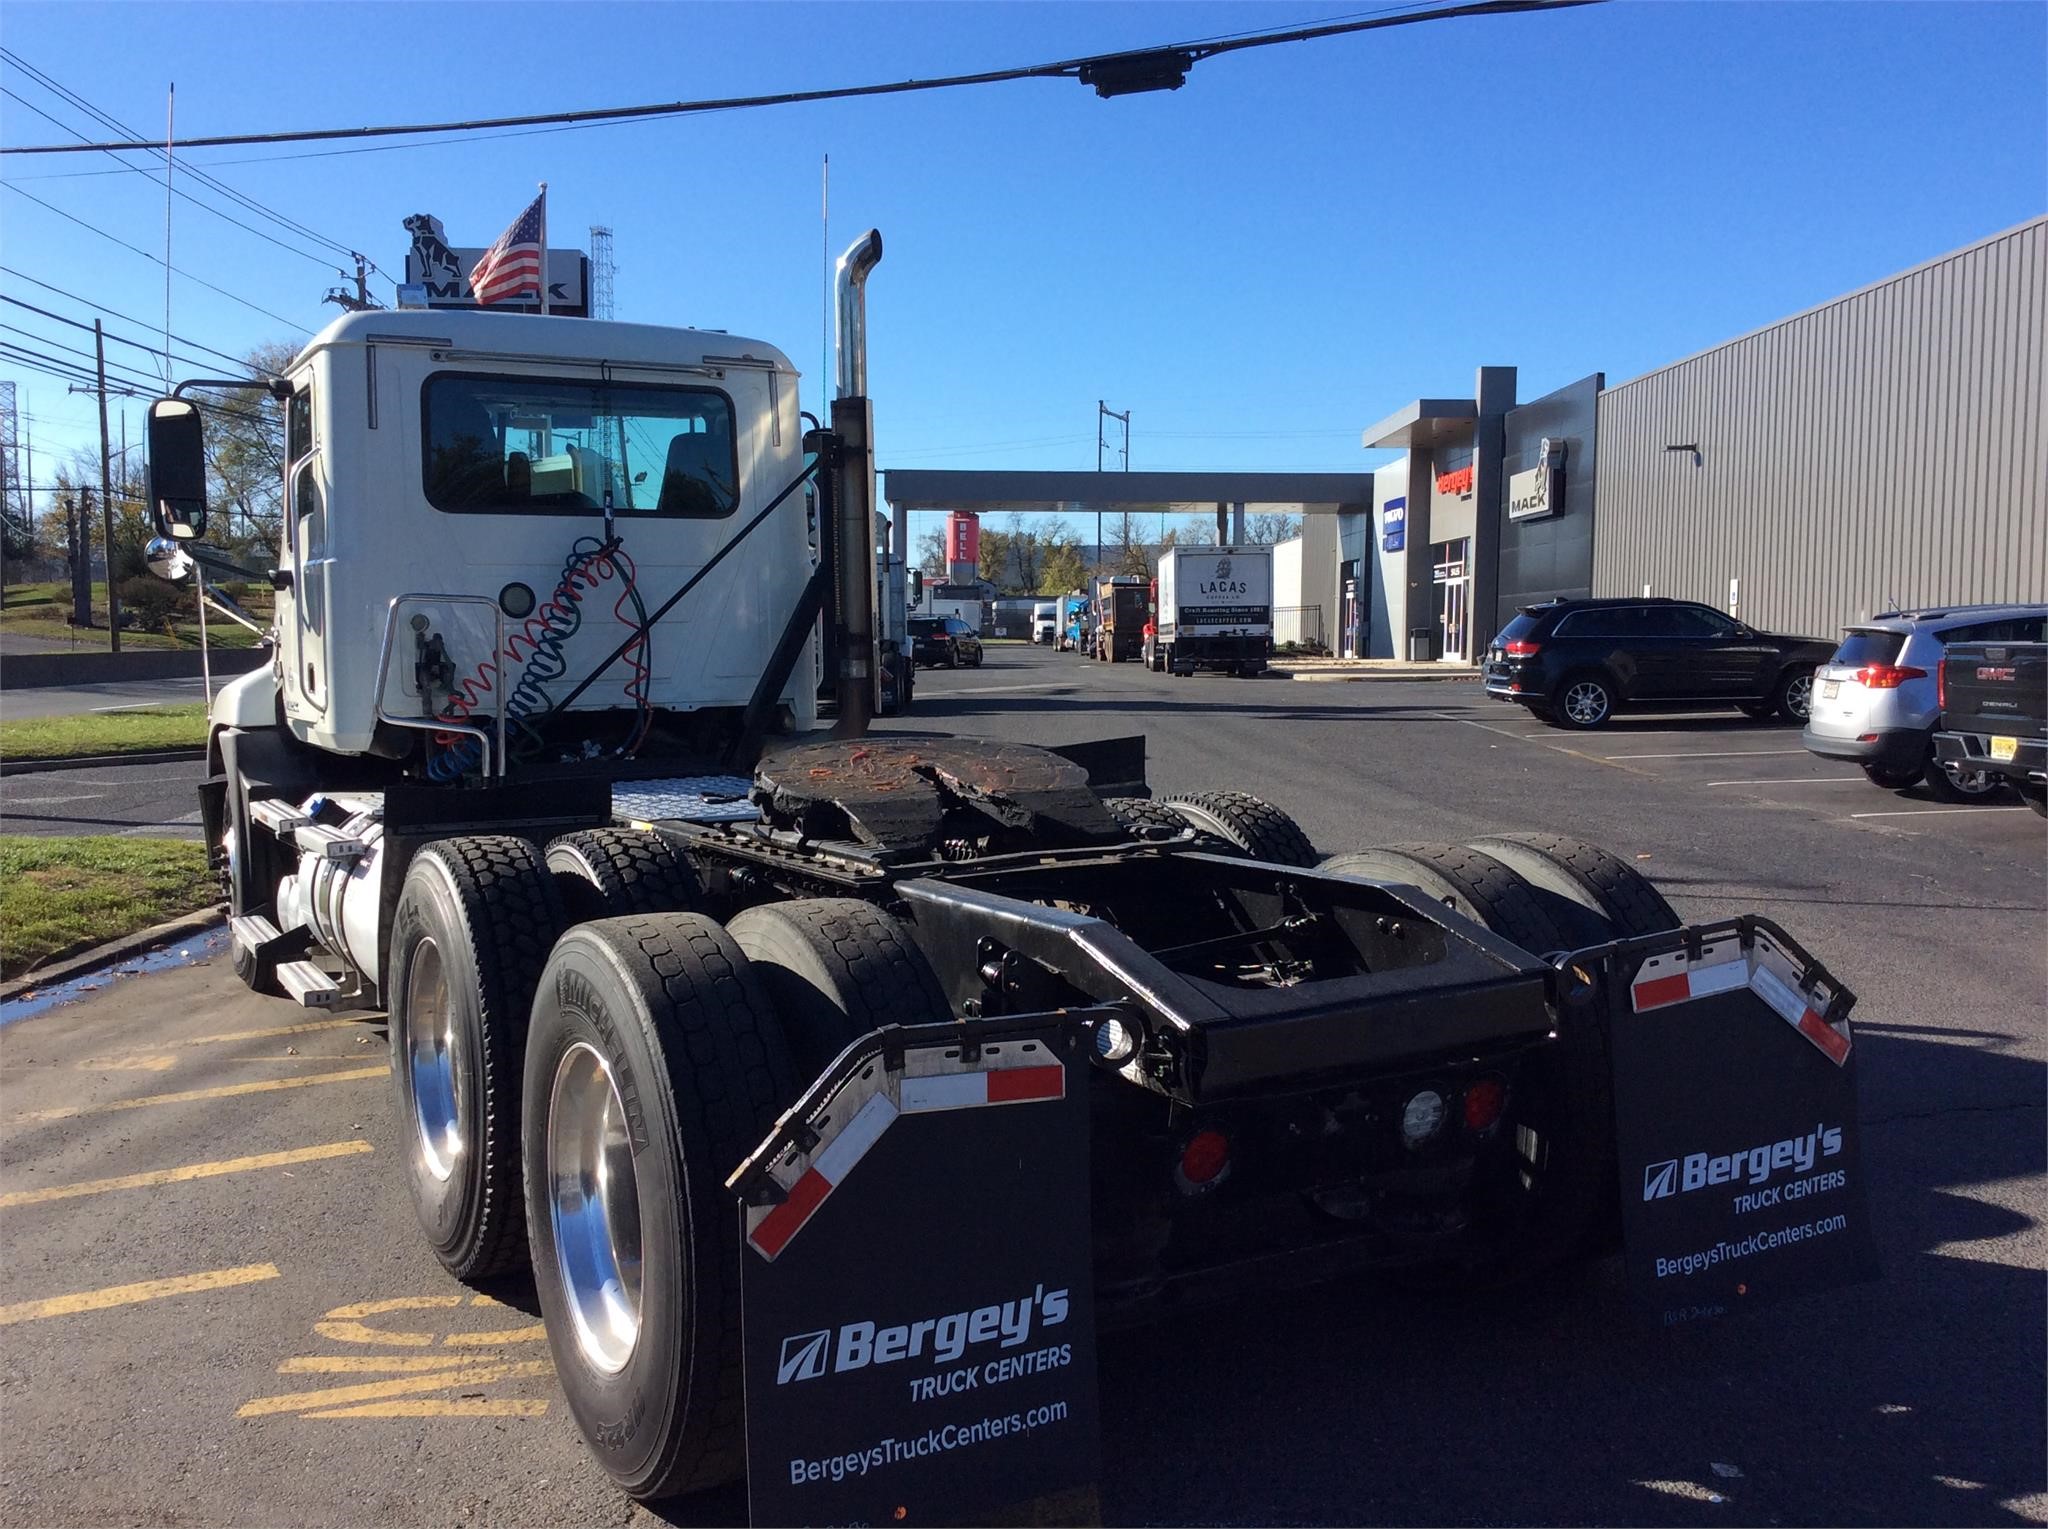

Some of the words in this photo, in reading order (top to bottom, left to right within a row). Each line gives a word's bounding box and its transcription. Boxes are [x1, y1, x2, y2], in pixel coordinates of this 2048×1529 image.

[1511, 494, 1546, 513] MACK
[959, 523, 967, 560] BELL
[1200, 581, 1247, 594] LACAS
[1976, 667, 2016, 681] GMC
[1981, 700, 2018, 708] DENALI
[1681, 1122, 1843, 1192] Bergey's
[1733, 1186, 1781, 1215] TRUCK
[1783, 1169, 1846, 1202] CENTERS
[1655, 1212, 1847, 1278] BergeysTruckCenters.com
[834, 1283, 1070, 1373] Bergey's
[909, 1365, 980, 1403] TRUCK
[983, 1343, 1073, 1385] CENTERS
[789, 1399, 1069, 1485] BergeysTruckCenters.com
